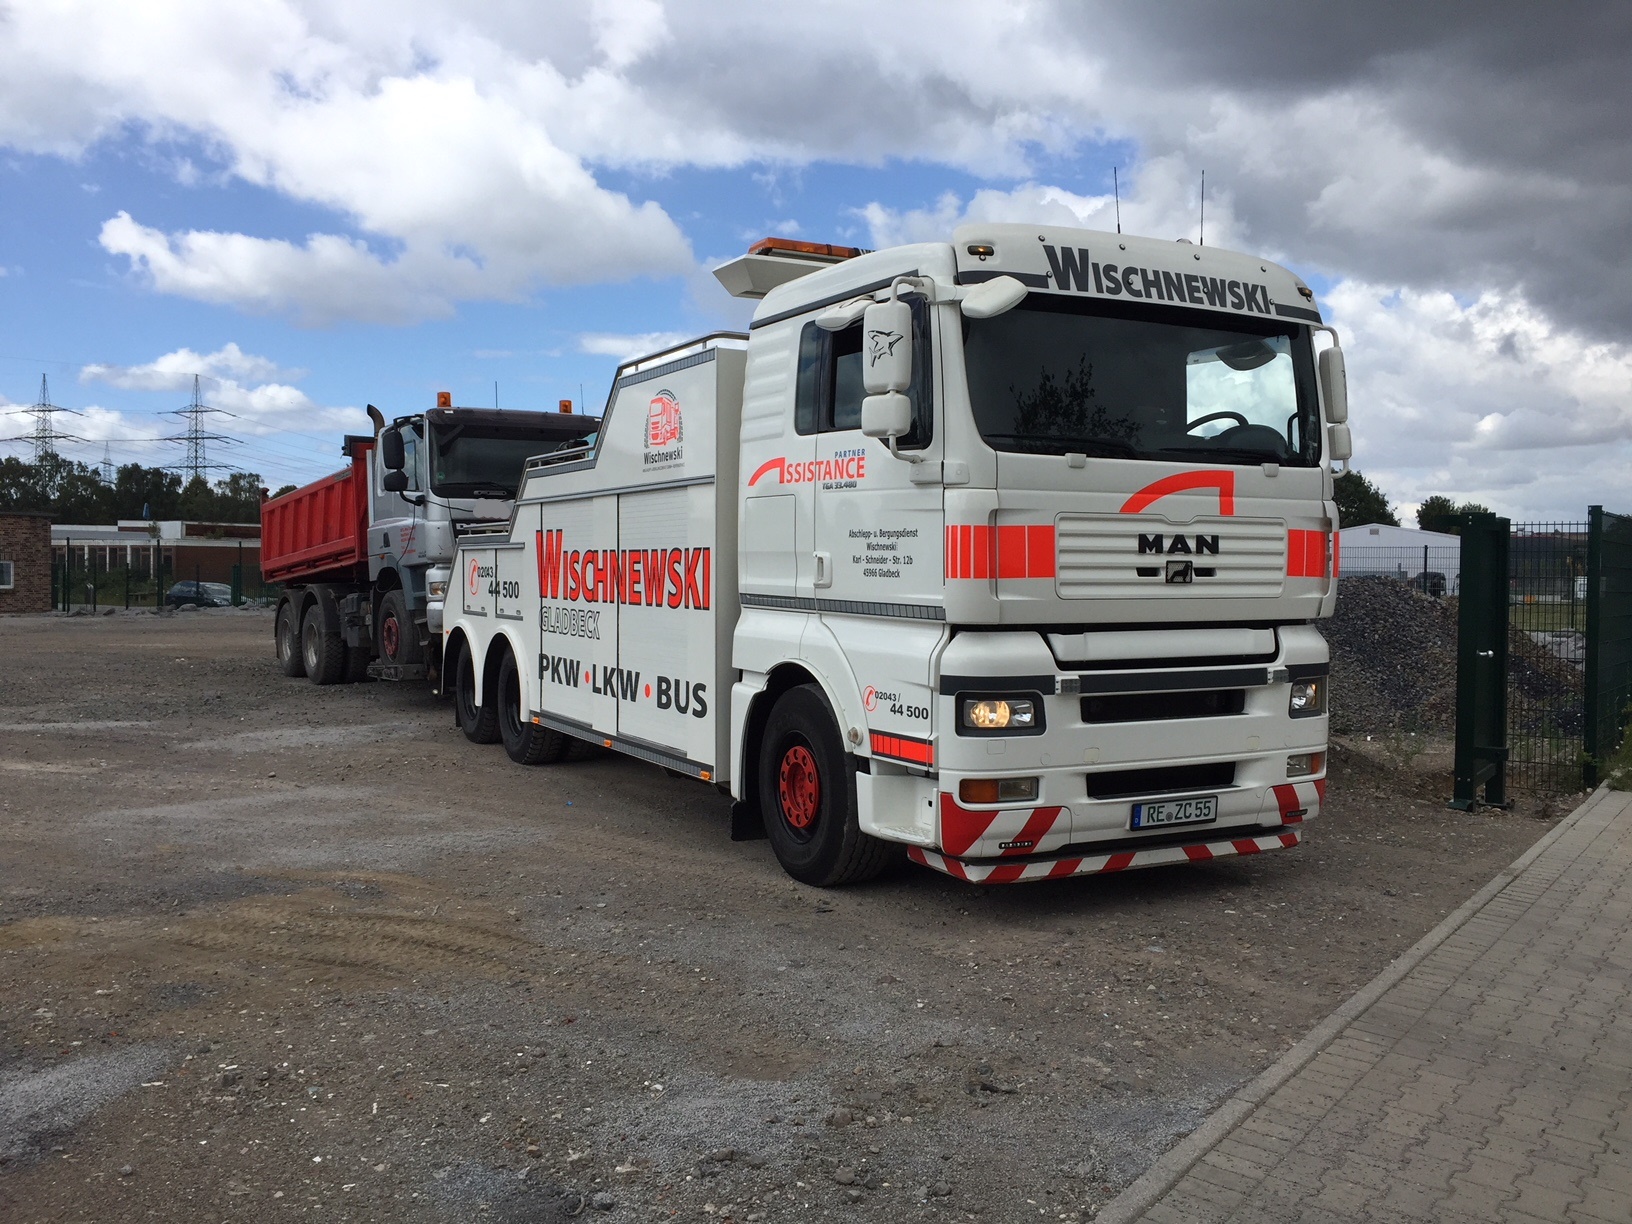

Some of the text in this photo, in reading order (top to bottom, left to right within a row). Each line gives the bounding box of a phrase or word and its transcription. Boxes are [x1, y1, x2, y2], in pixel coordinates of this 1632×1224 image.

[1043, 244, 1271, 315] WISCHNEWSKI
[643, 446, 683, 465] Wischnewski
[834, 448, 866, 459] PARTNER
[879, 528, 918, 540] Bergungsdienst
[866, 542, 898, 551] Wischnewski
[1138, 534, 1219, 554] MAN
[536, 529, 711, 610] WISCHNEWSKI
[865, 555, 889, 565] Schneider
[878, 568, 901, 578] Gladbeck
[488, 580, 520, 599] 44 500
[540, 606, 600, 640] GLADBECK
[538, 653, 708, 718] PKW LKW BUS
[890, 703, 929, 720] 44 500
[1147, 800, 1212, 823] RE ZC 55
